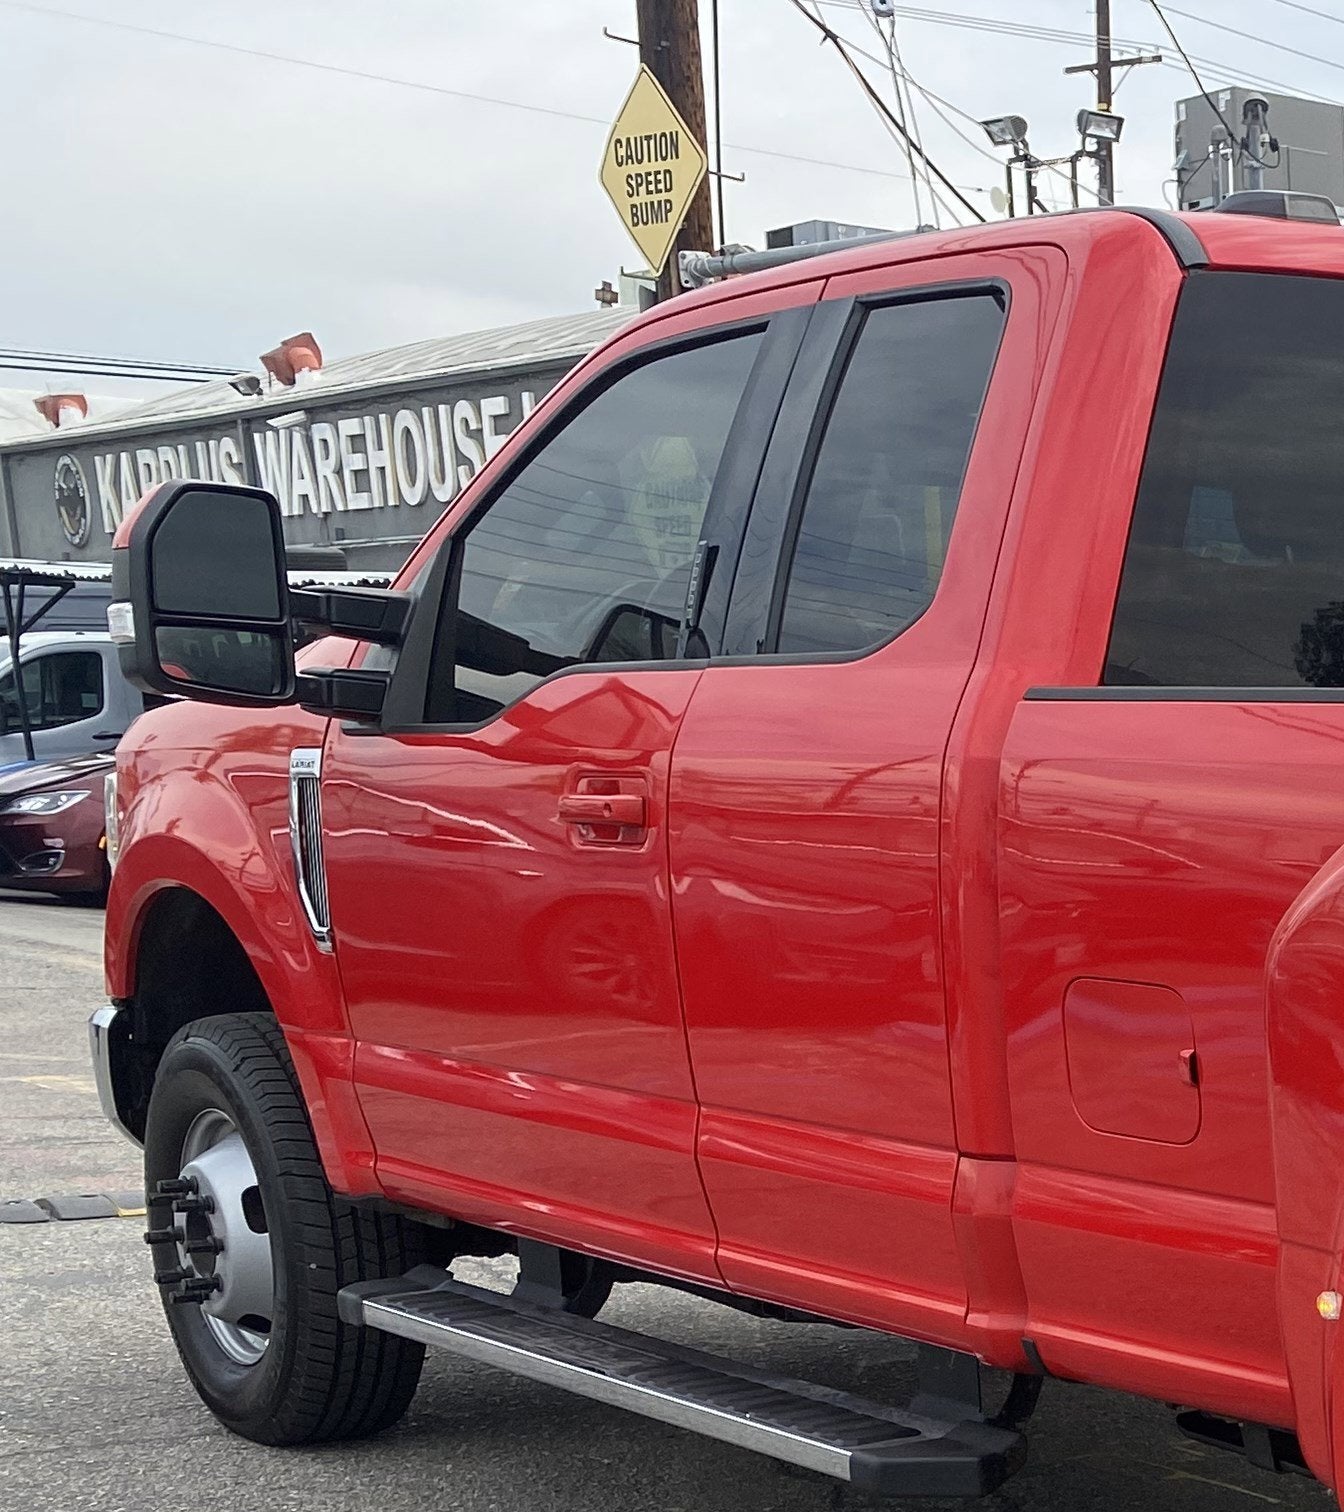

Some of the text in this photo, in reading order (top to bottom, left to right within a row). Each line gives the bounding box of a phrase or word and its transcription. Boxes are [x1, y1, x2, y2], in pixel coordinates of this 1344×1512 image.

[614, 130, 680, 168] CAUTION
[625, 168, 673, 198] SPEED
[630, 199, 673, 227] BUMP
[253, 395, 510, 518] WAREHOUSE
